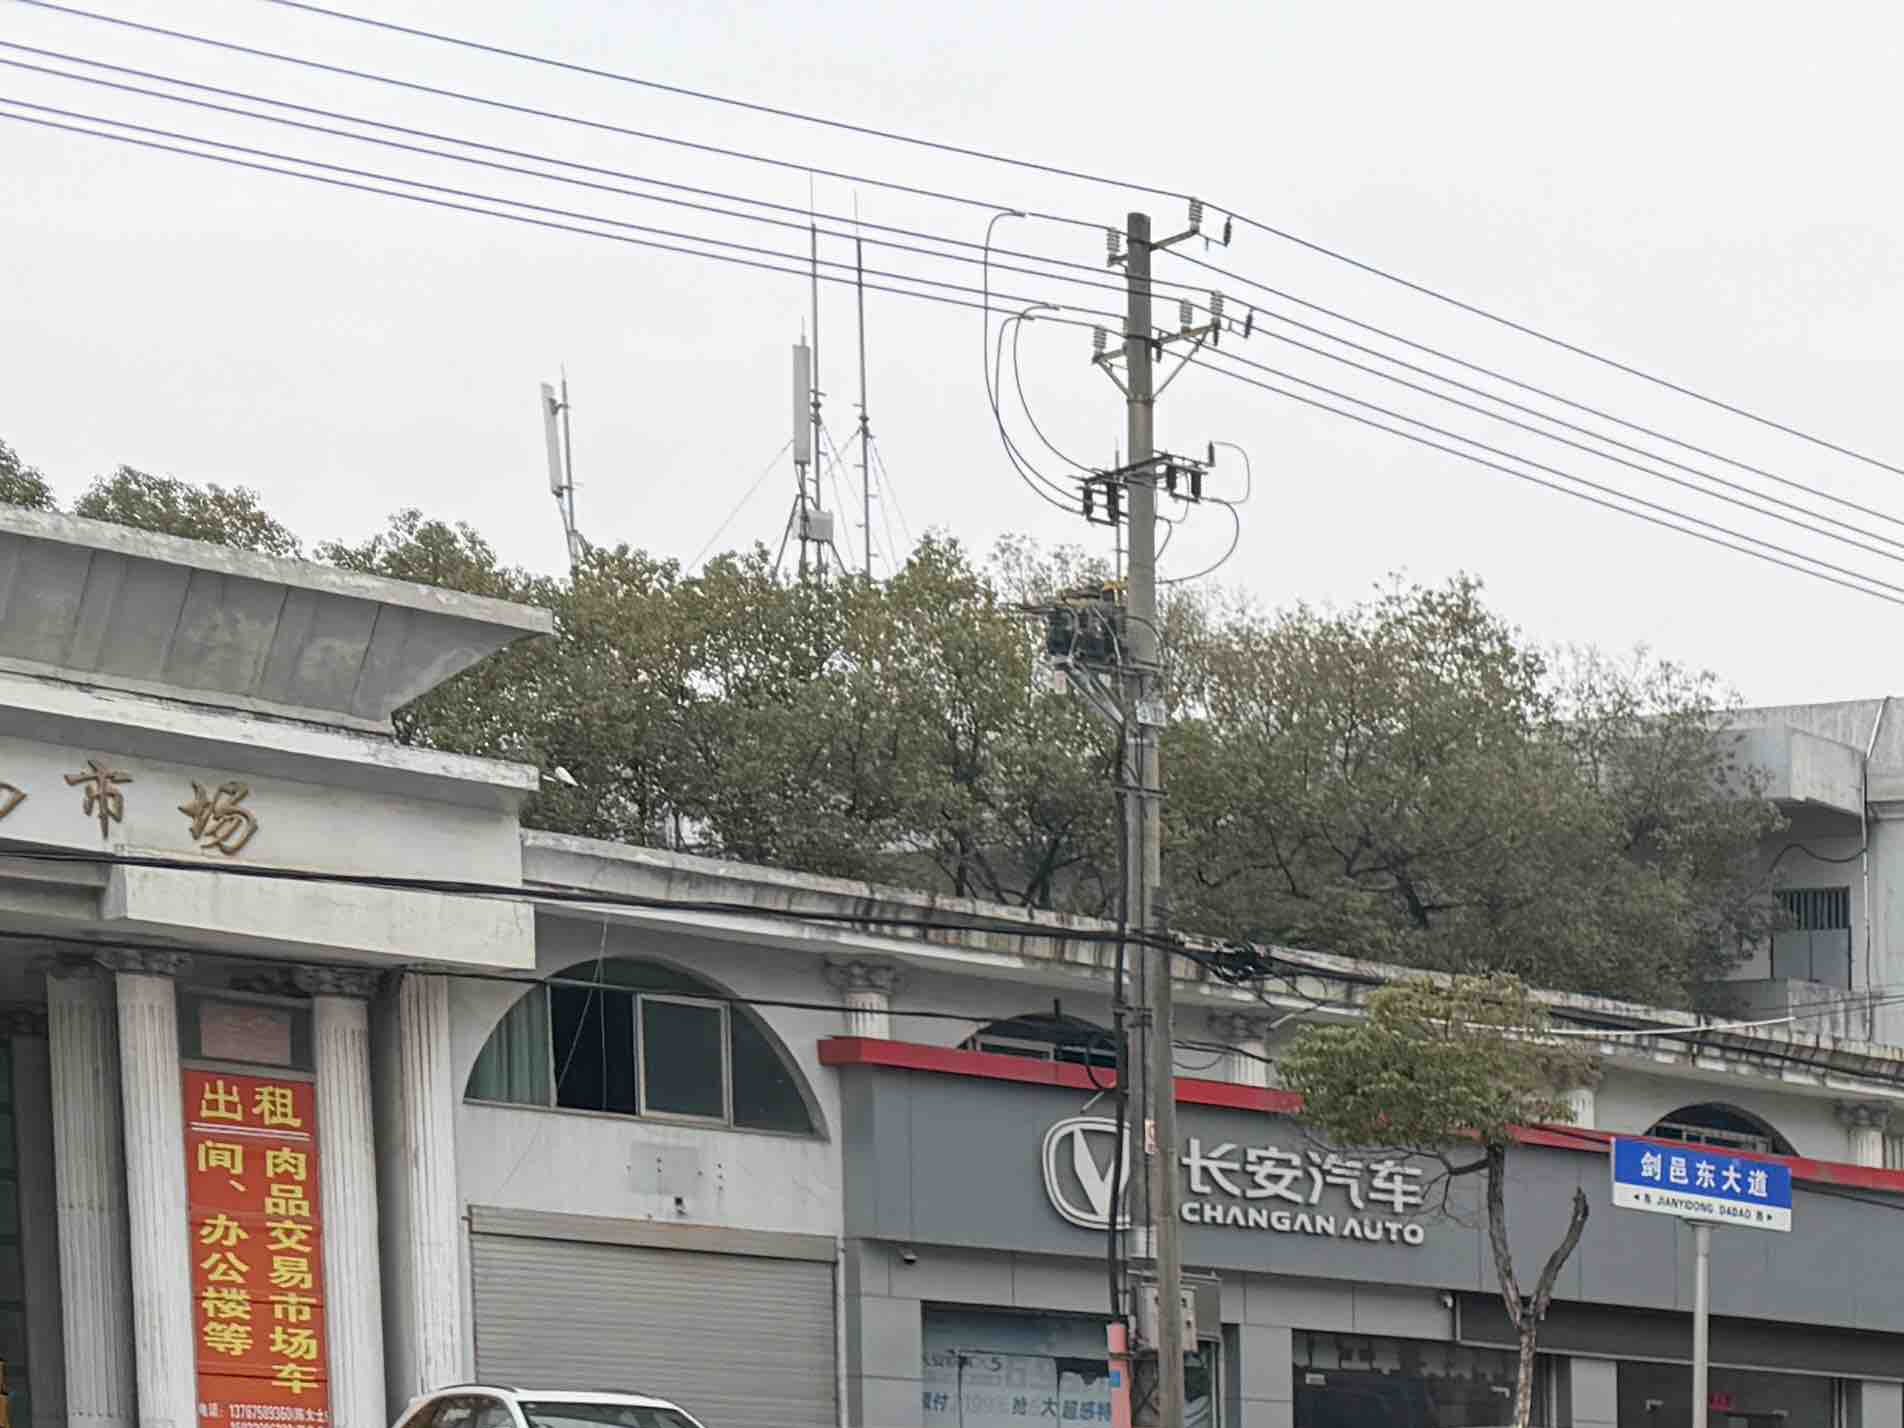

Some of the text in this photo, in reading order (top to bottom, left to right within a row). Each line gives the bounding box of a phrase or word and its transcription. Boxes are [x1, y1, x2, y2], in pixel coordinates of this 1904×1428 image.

[200, 1079, 303, 1127] 出租
[1181, 1137, 1425, 1214] 长安汽车
[1640, 1151, 1769, 1198] 剑邑东大道
[197, 1139, 254, 1357] 间、办公楼等
[1180, 1201, 1426, 1246] CHANGAN AUTO
[264, 1146, 319, 1395] 肉品交易市场车
